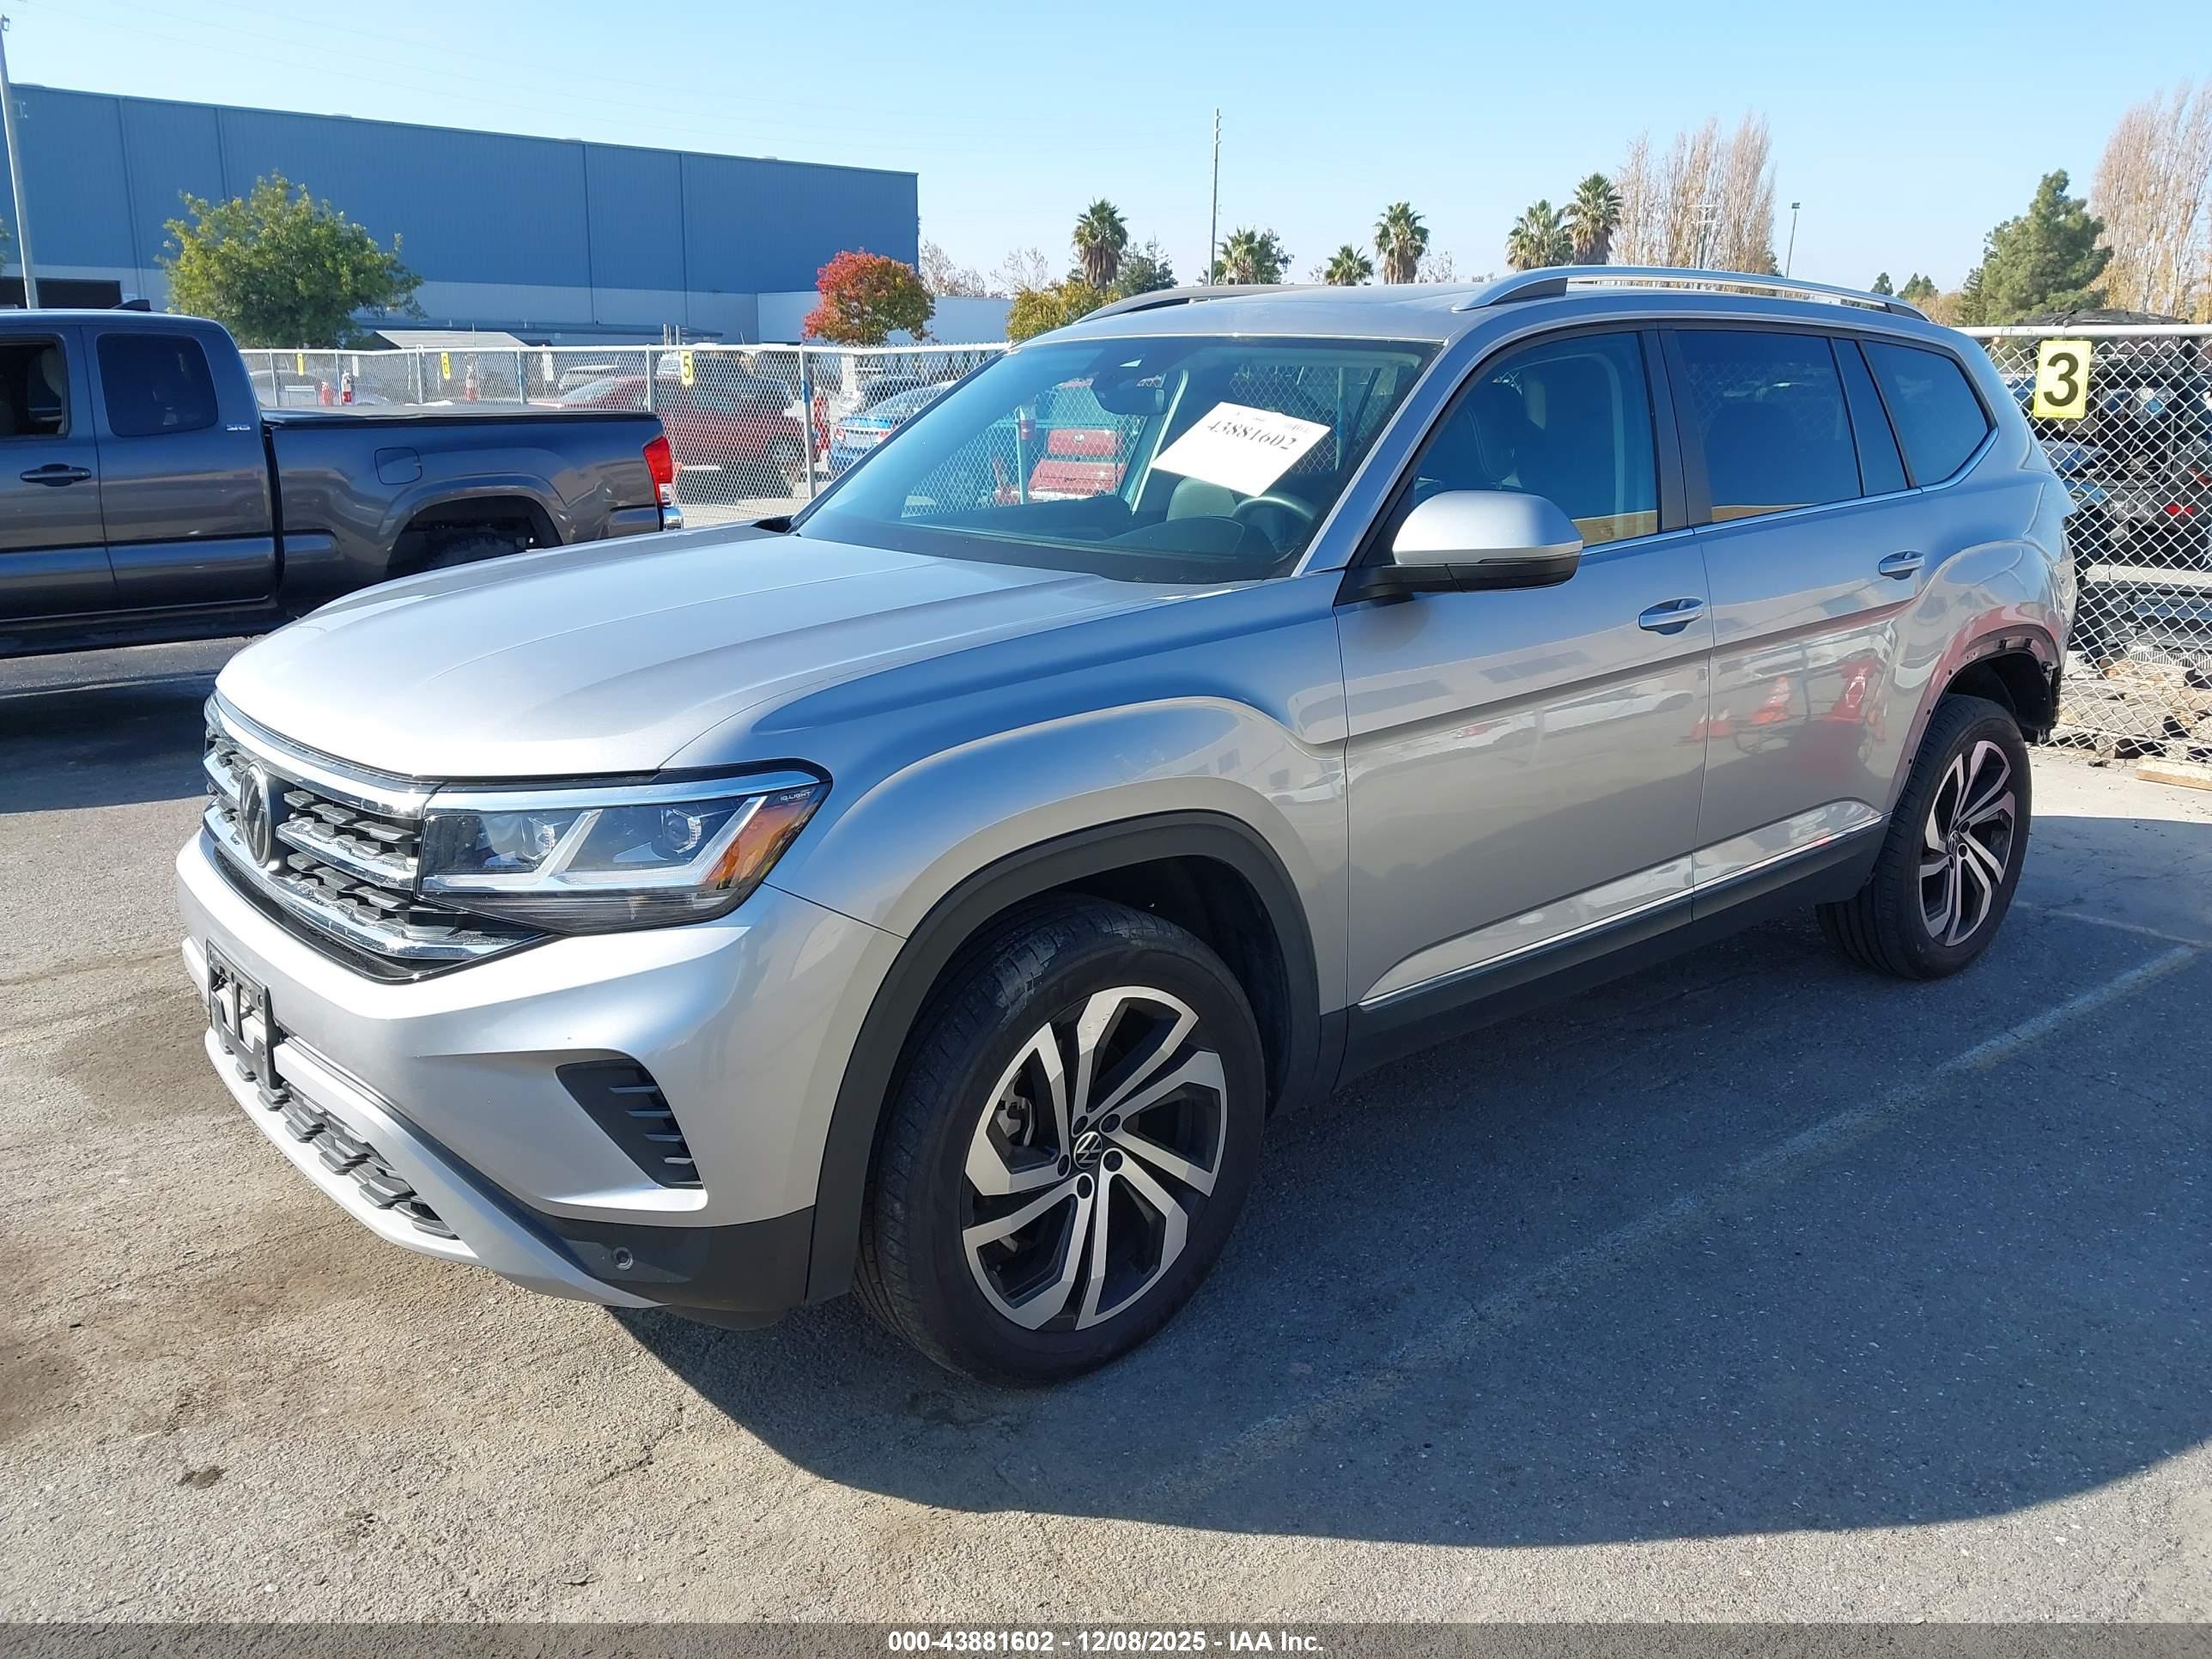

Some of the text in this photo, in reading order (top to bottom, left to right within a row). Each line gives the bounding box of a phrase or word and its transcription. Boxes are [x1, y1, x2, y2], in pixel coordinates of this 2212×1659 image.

[684, 356, 690, 378] 5
[2044, 352, 2079, 407] 3
[1207, 421, 1297, 450] 43881602
